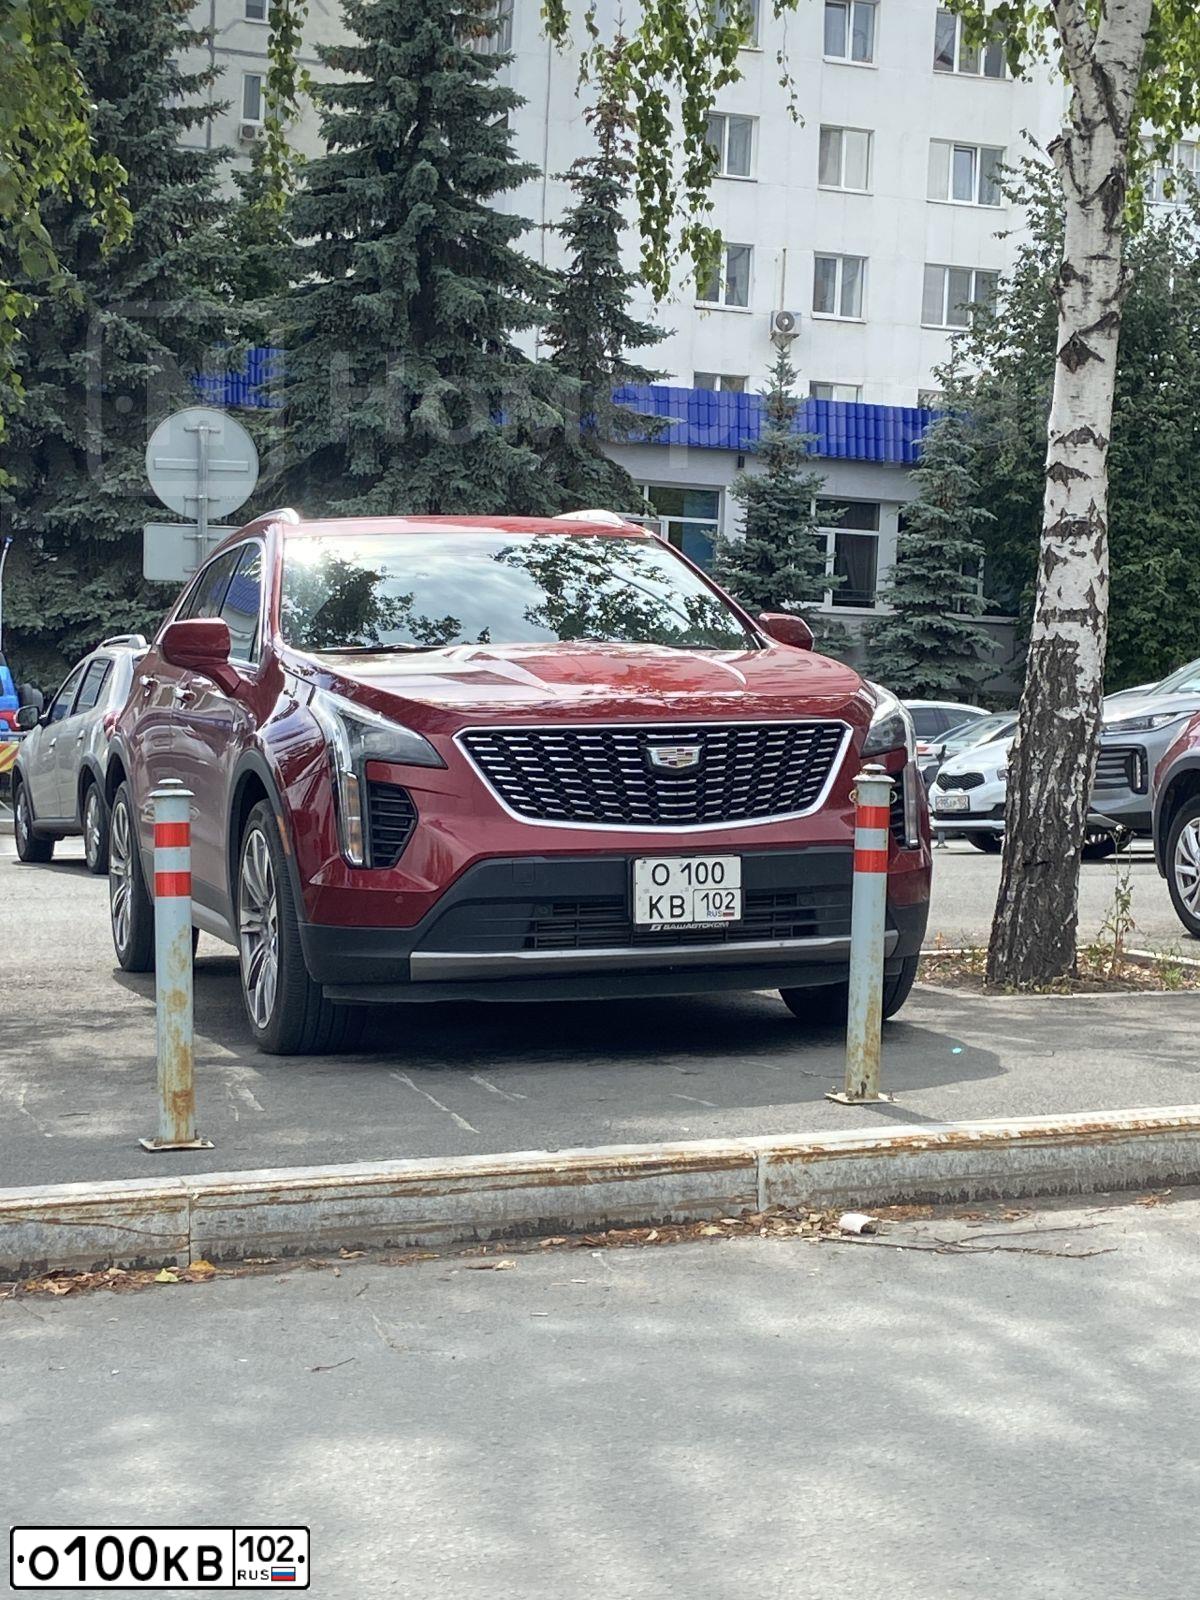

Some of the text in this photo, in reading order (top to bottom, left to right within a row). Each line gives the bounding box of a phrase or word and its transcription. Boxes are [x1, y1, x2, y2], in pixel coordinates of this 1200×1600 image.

[651, 861, 725, 886] О 100
[648, 895, 686, 919] КВ
[701, 891, 736, 911] 102
[707, 910, 723, 918] RUS
